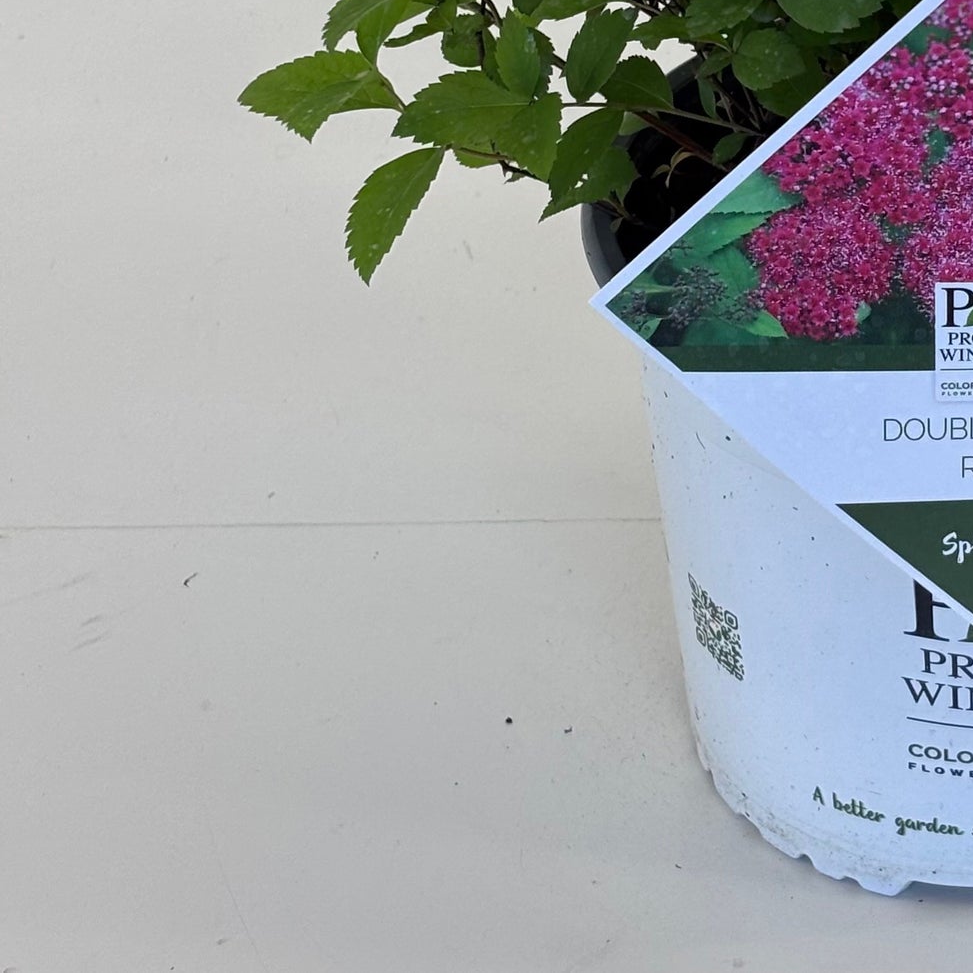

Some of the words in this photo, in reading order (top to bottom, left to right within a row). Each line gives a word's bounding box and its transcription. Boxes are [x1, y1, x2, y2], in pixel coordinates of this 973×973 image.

[812, 785, 825, 805] A
[832, 791, 886, 823] better
[895, 816, 965, 836] garden
